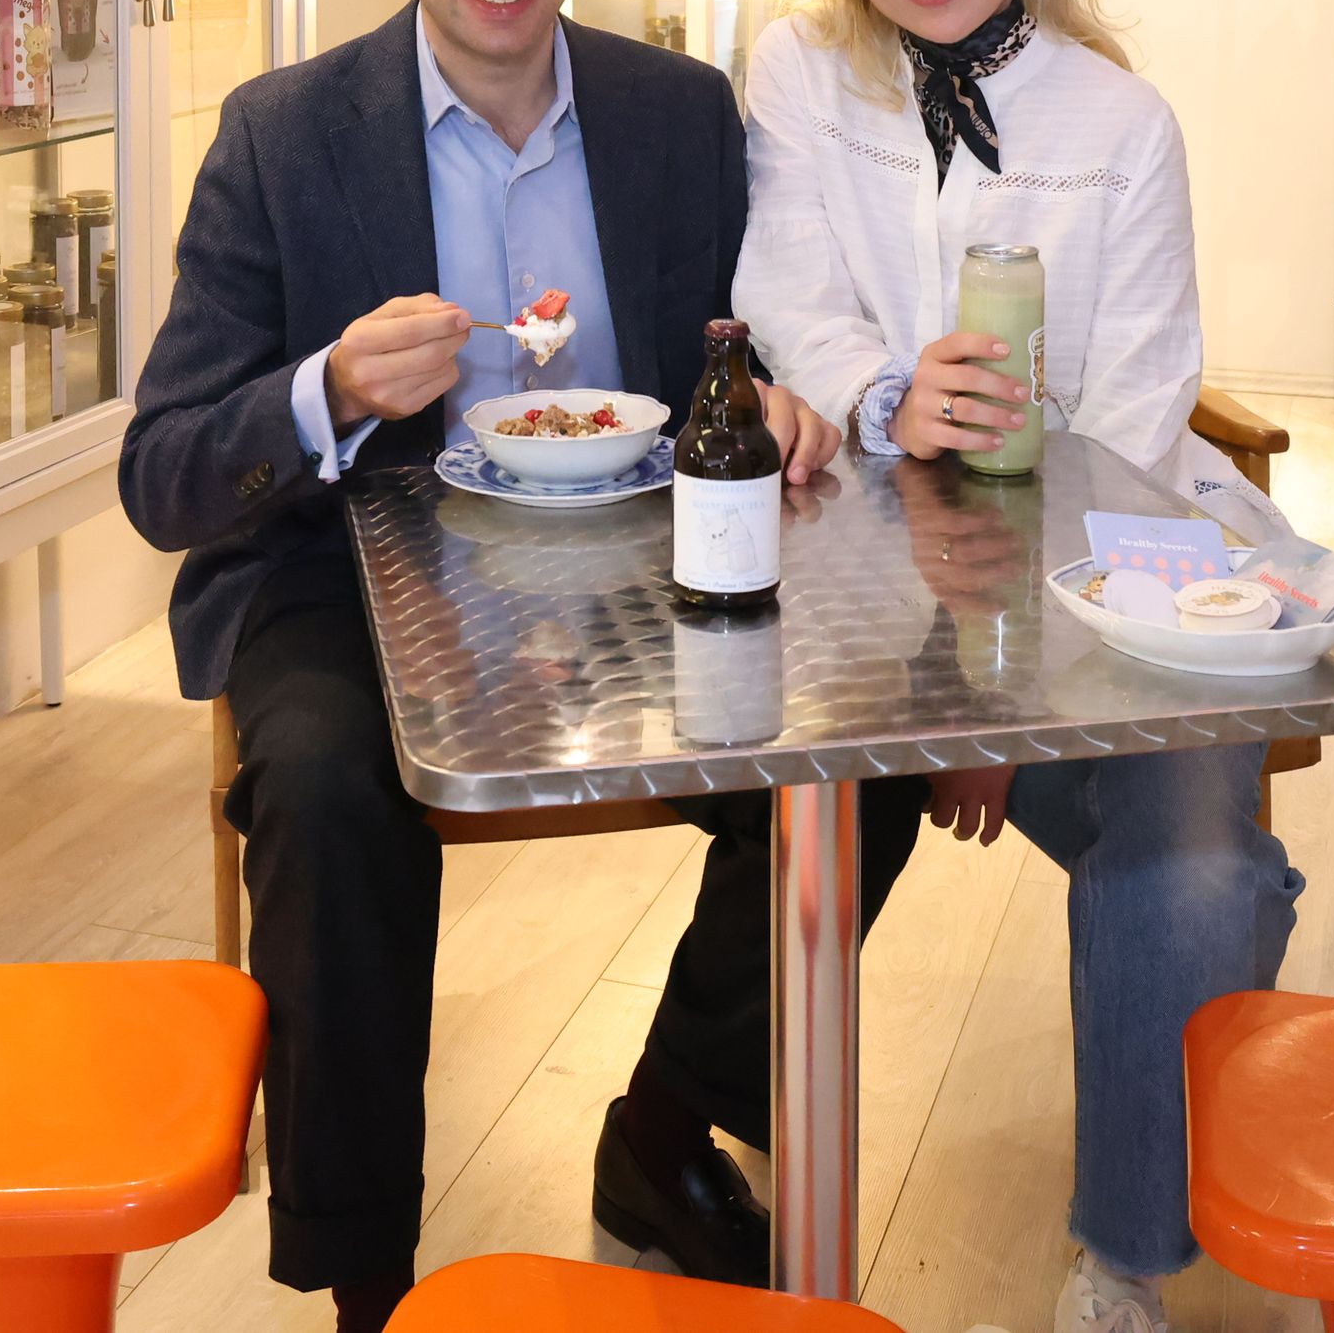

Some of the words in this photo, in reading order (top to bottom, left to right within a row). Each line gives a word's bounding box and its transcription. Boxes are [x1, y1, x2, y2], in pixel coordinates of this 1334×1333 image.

[1118, 537, 1157, 551] Healthy
[1159, 542, 1198, 554] Secrets
[1258, 570, 1289, 595] Healthy
